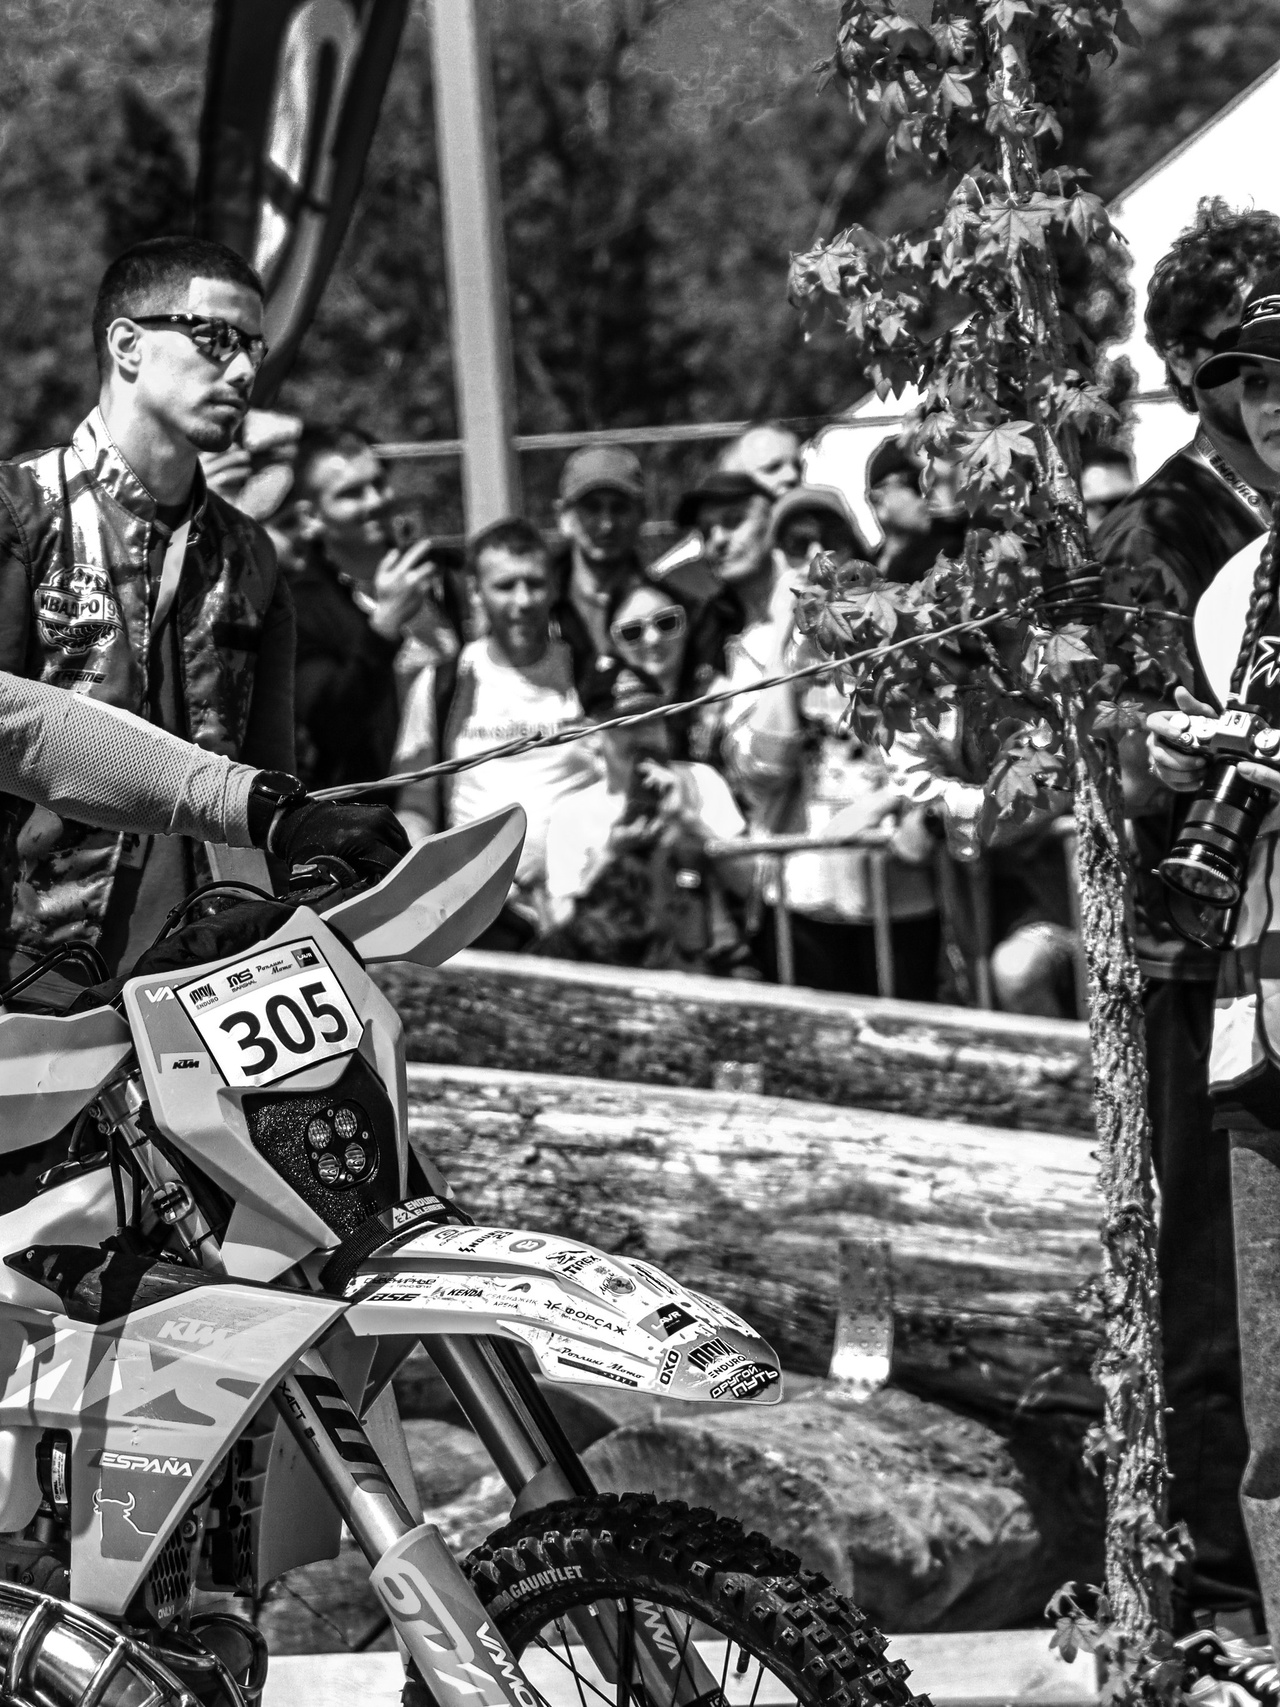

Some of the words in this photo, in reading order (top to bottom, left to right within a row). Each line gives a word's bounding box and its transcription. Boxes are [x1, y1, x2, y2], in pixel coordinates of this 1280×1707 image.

[195, 996, 219, 1010] ENDURO
[219, 981, 349, 1077] 305
[172, 1058, 200, 1070] KTM
[404, 1196, 441, 1211] ENDURO
[414, 1203, 446, 1216] ELEMENT
[447, 1288, 484, 1298] KENDA
[565, 1306, 627, 1336] ФОРСАЖ
[650, 1311, 681, 1330] LAVR
[708, 1356, 746, 1379] ENDURO
[711, 1365, 758, 1399] ДРУГОЙ
[732, 1370, 779, 1398] ПУТЬ
[277, 1380, 307, 1421] XACT
[99, 1451, 193, 1477] ESPAÑA
[509, 1565, 583, 1598] GAUNTLET
